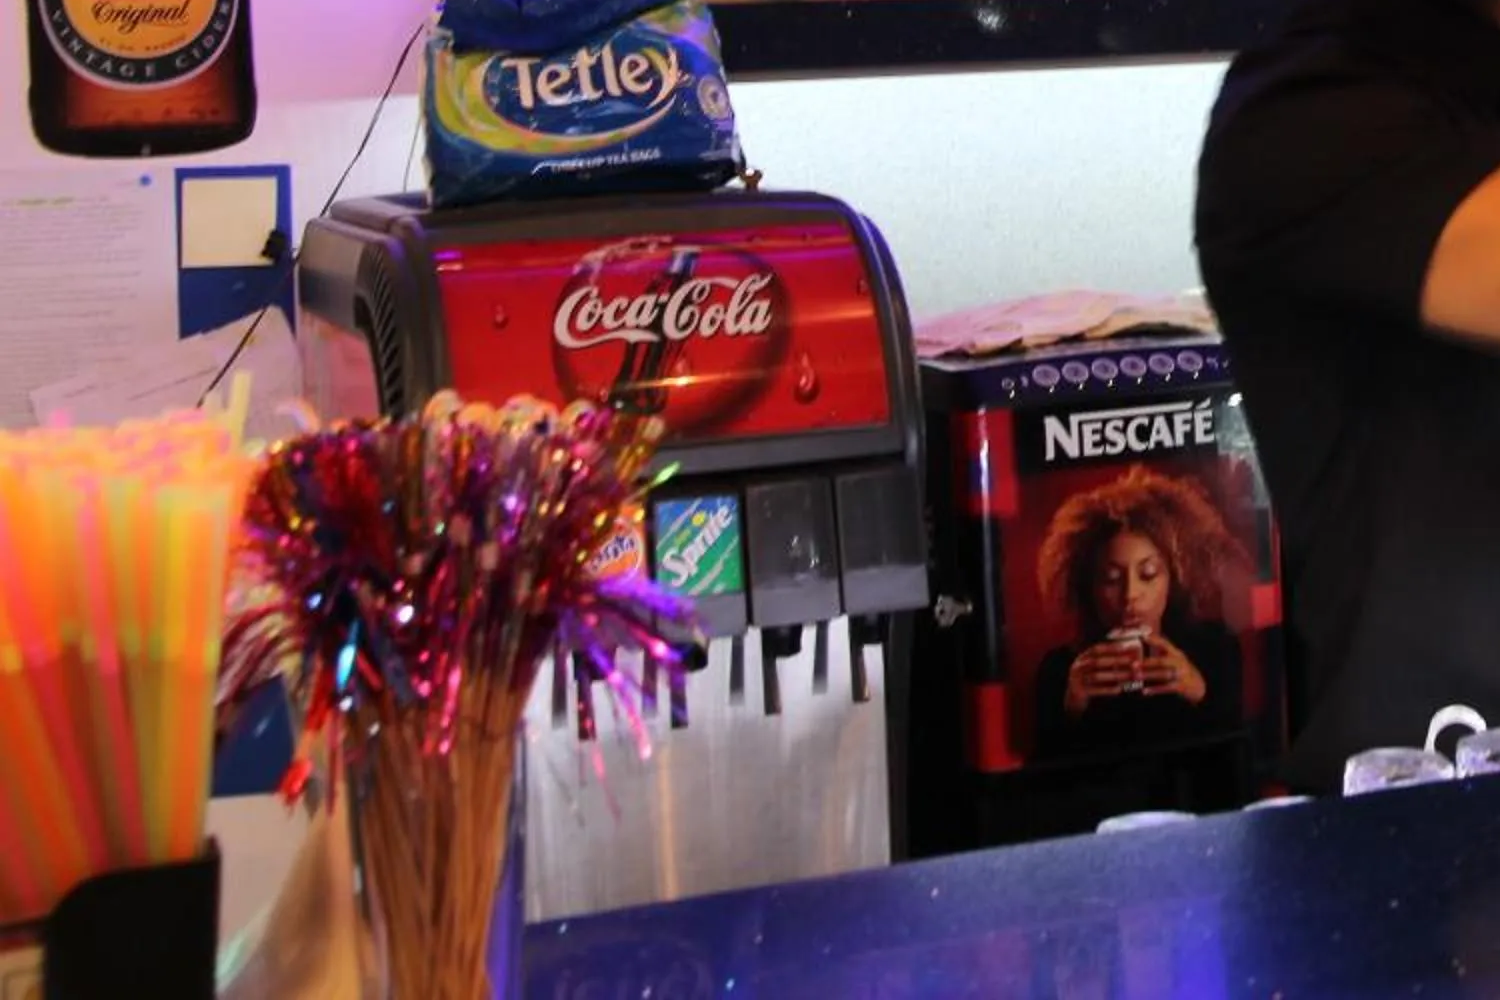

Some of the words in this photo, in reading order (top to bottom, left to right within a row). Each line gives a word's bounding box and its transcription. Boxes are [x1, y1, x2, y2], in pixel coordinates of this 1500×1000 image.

[502, 38, 681, 110] Tetley
[553, 271, 774, 349] Coca-Cola
[1044, 399, 1217, 461] NESCAFÉ
[661, 504, 734, 588] Sprite
